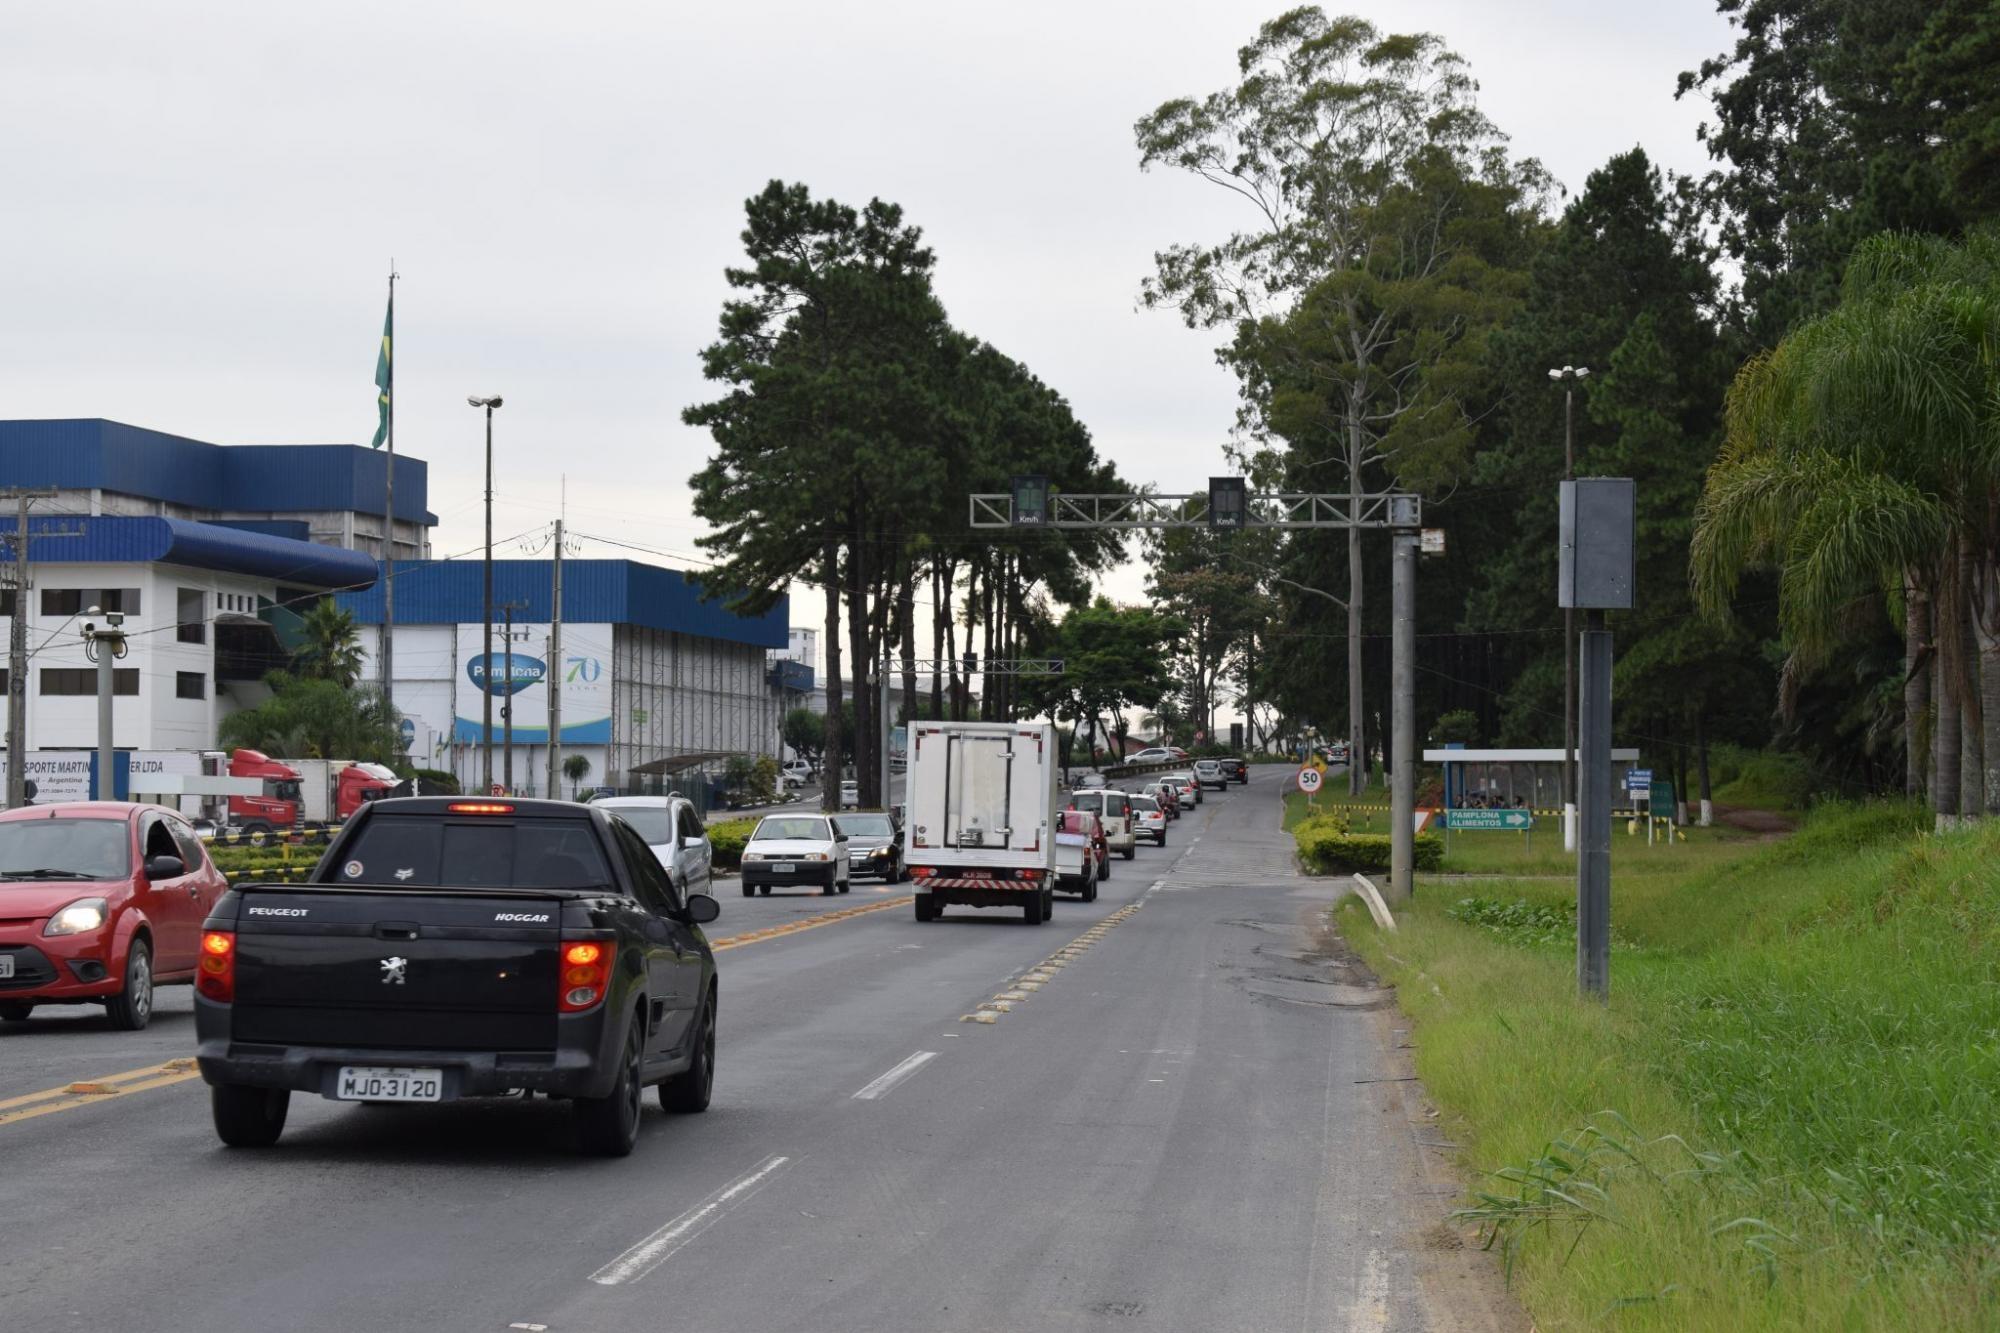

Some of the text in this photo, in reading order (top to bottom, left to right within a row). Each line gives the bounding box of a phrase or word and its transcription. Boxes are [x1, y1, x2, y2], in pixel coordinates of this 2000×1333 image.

[566, 657, 600, 683] 70
[142, 761, 163, 774] LTDA
[1302, 772, 1318, 783] 50
[1452, 811, 1500, 819] PAMPLONA
[1450, 819, 1502, 827] ALIMENTOS
[248, 907, 310, 917] PEUGEOT
[494, 913, 550, 923] HOGGAR
